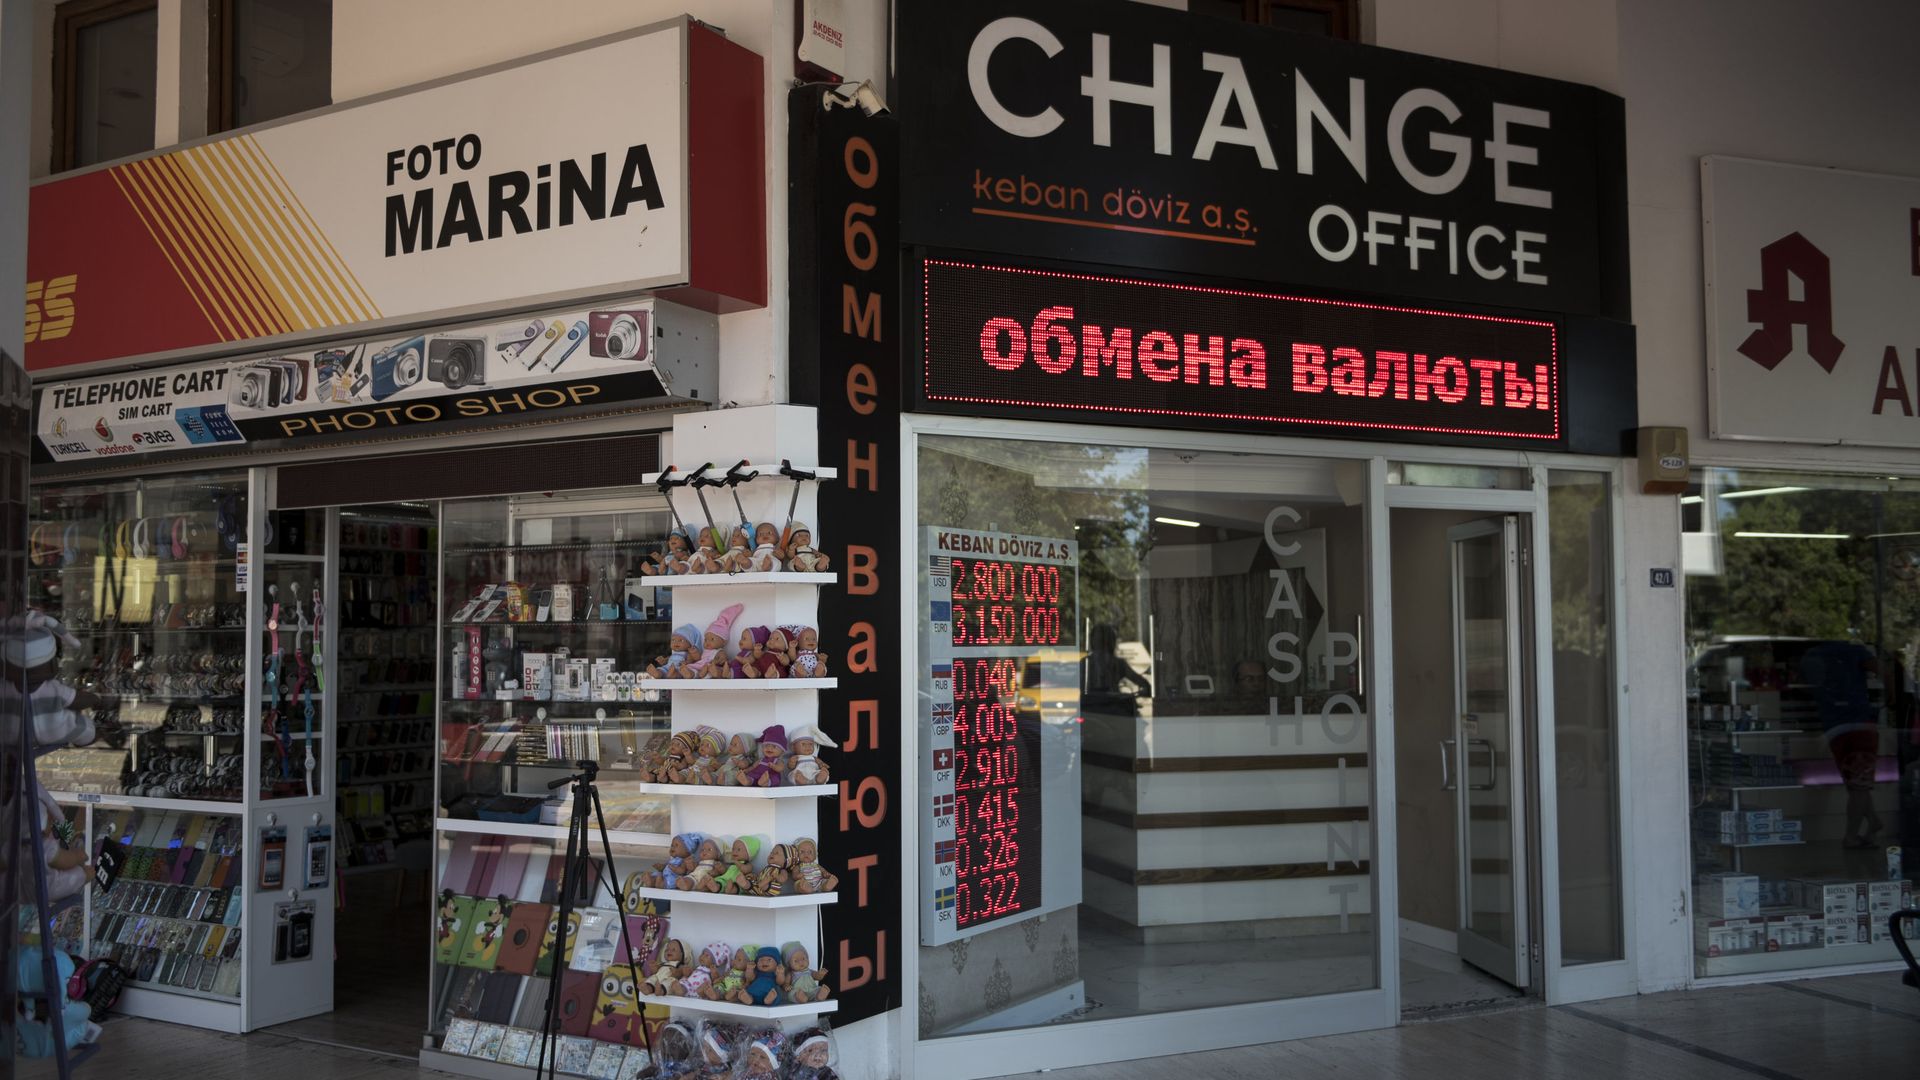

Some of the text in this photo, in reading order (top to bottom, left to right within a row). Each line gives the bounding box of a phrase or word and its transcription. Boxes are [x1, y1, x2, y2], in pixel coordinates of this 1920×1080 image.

[968, 16, 1553, 209] CHANGE
[386, 133, 482, 186] FOTO
[385, 143, 665, 258] MARiNA
[973, 169, 1258, 238] keban döviz a.ş.
[1308, 204, 1548, 285] OFFICE
[980, 305, 1549, 410] обмена валюты
[53, 368, 229, 409] TELEPHONE CART
[1872, 345, 1920, 417] A
[118, 402, 173, 420] SIM CART
[280, 384, 600, 437] PHOTO SHOP
[50, 441, 91, 455] TURKCELL
[95, 443, 135, 455] vodafone
[145, 430, 175, 445] avea
[938, 532, 994, 554] KEBAN
[933, 577, 947, 587] USD
[952, 560, 1060, 603] 2.800 000
[934, 623, 948, 632] EURO
[952, 605, 1060, 644] 3.150 000
[935, 679, 948, 690] RUB
[952, 660, 1016, 700] 0.040
[936, 726, 950, 736] GBP
[953, 702, 1018, 745] 4.005
[1264, 506, 1362, 933] CASH POINT
[936, 772, 950, 782] CHF
[955, 745, 1019, 790] 2.910
[937, 818, 951, 828] DKK
[955, 788, 1020, 836] 0.415
[939, 866, 953, 875] NOK
[956, 828, 1020, 878] 0.326
[938, 911, 952, 922] SEK
[957, 871, 1021, 925] 0.322
